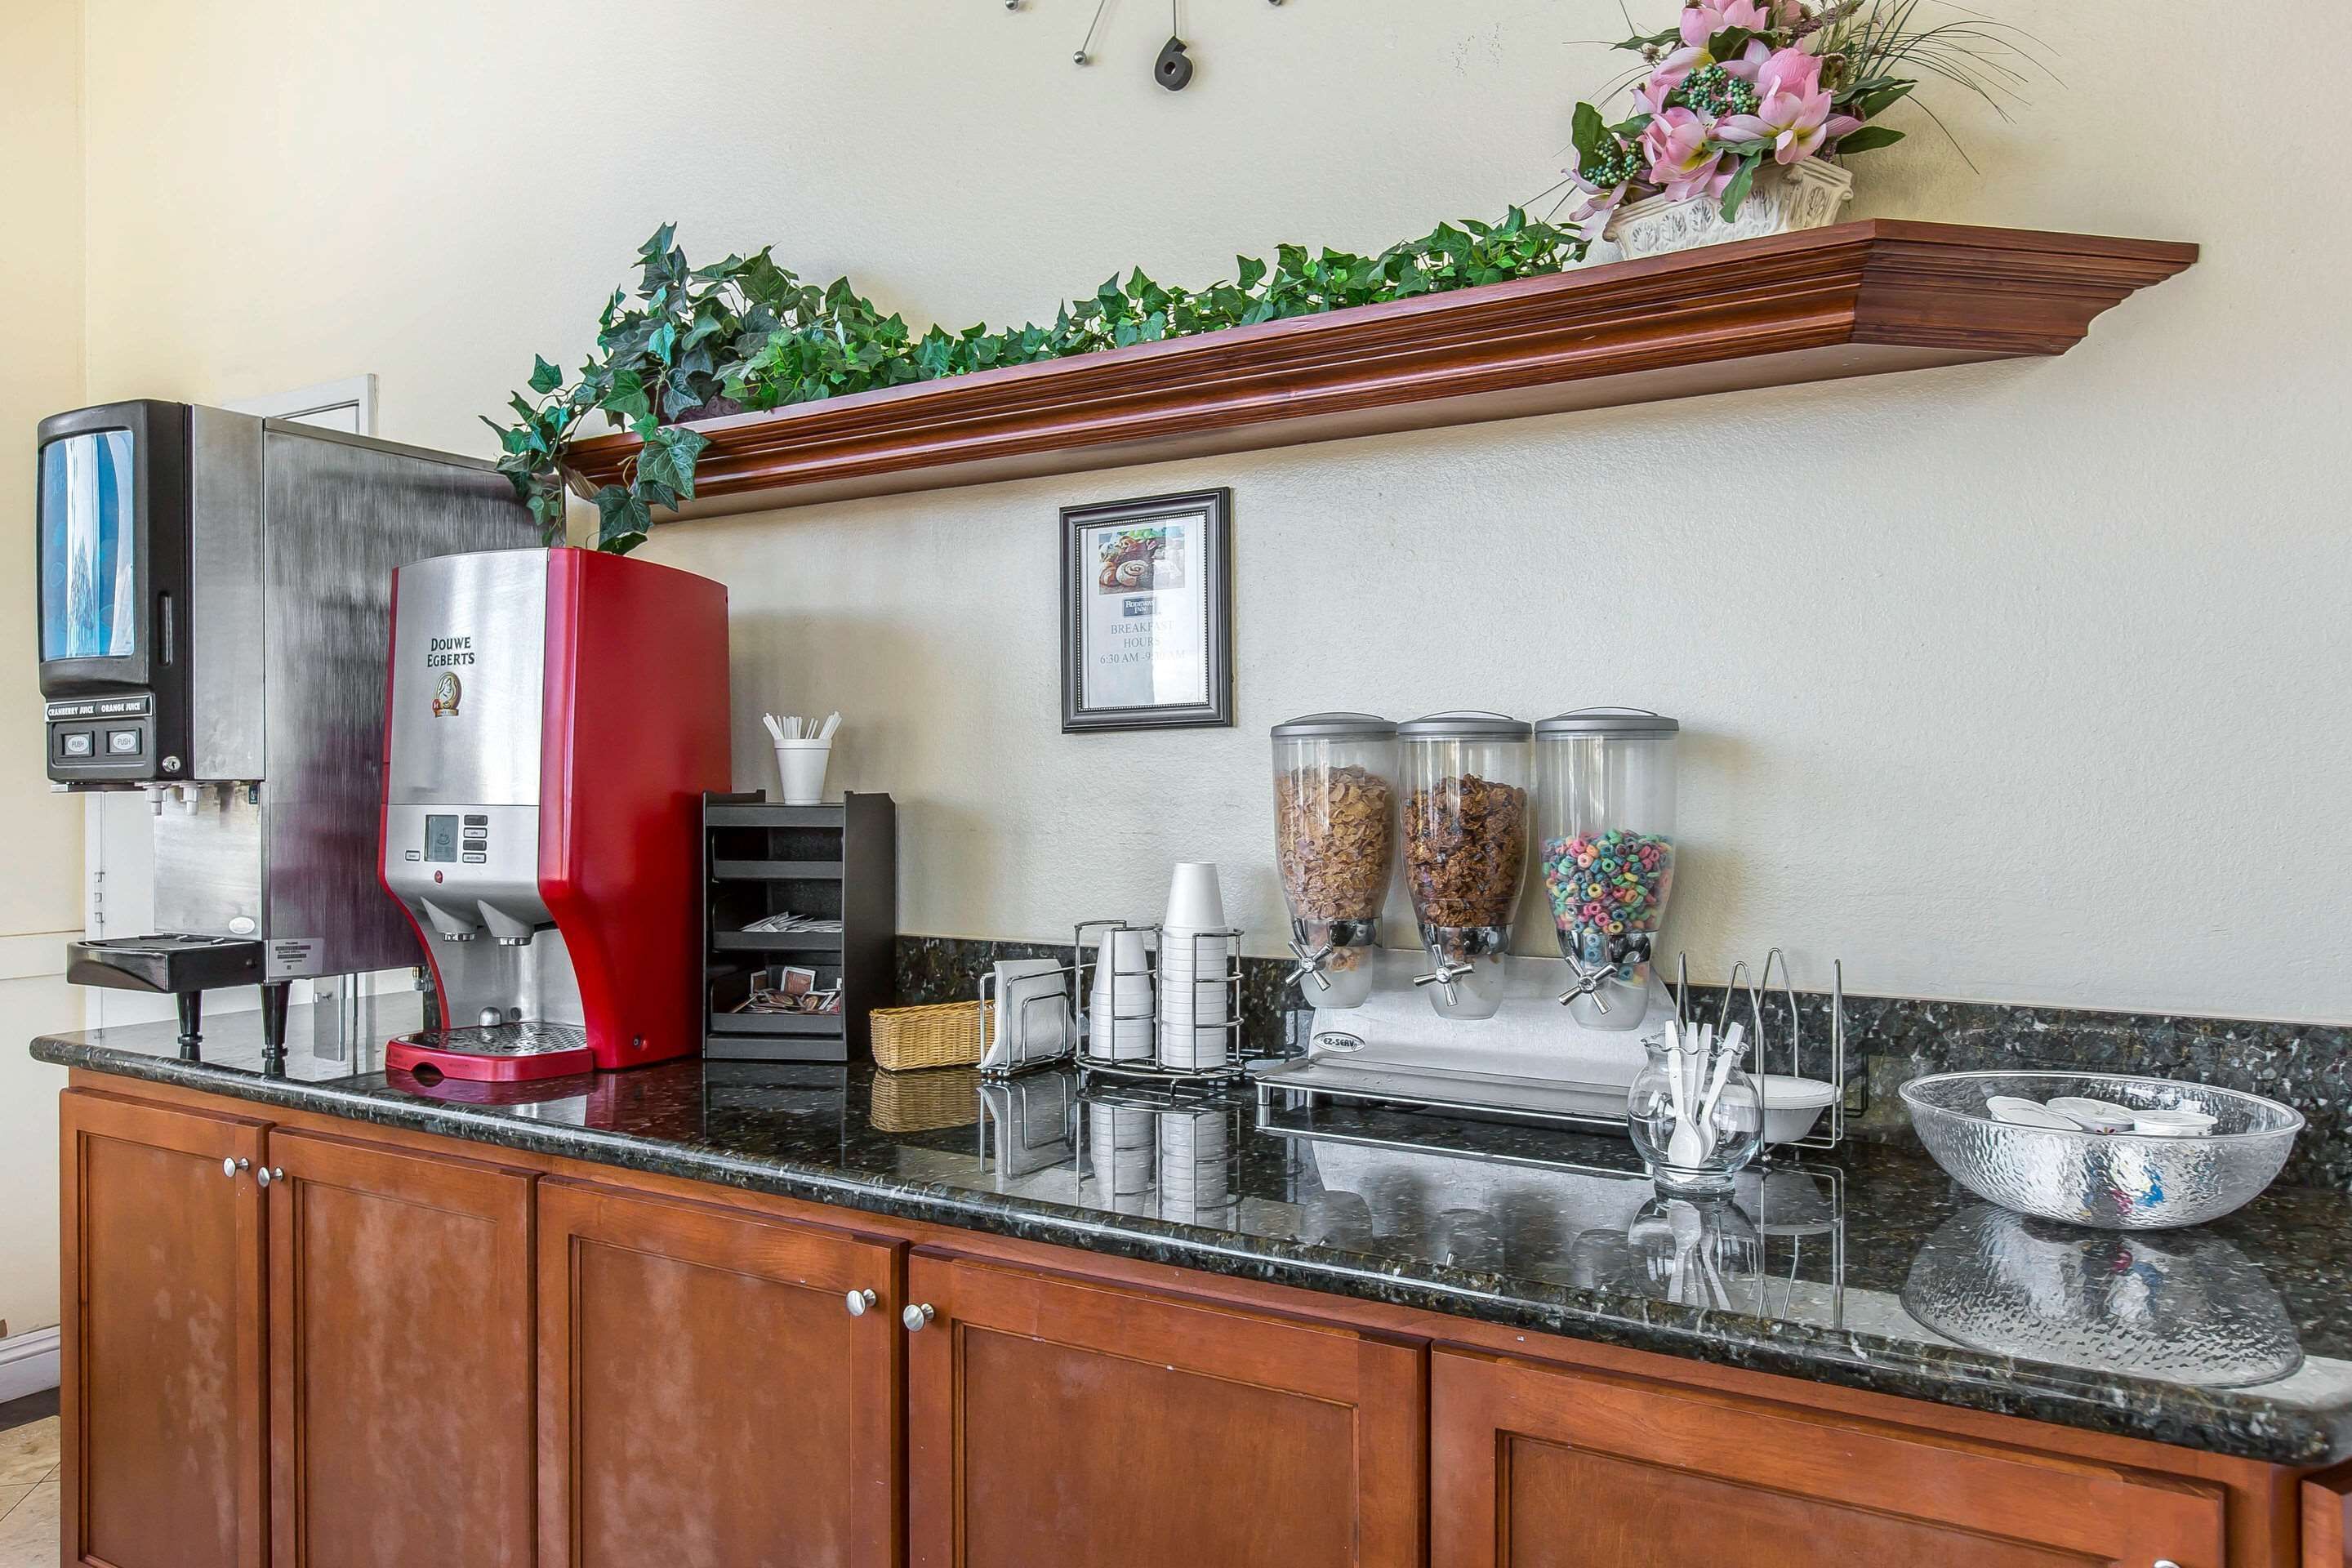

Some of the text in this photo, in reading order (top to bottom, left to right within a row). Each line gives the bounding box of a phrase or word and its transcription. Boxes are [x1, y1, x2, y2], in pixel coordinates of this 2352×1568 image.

[1154, 36, 1193, 91] 6
[1111, 620, 1174, 635] BREAKFAST
[431, 637, 471, 652] DOUWE
[1124, 636, 1160, 648] HOURS
[427, 653, 475, 668] EGBERTS
[1100, 653, 1120, 665] 6:30
[1122, 653, 1139, 663] AM
[48, 706, 94, 716] CRANBERRY JUICE
[101, 702, 140, 712] ORANGE JUICE
[1323, 1037, 1354, 1046] EZ-SERV
